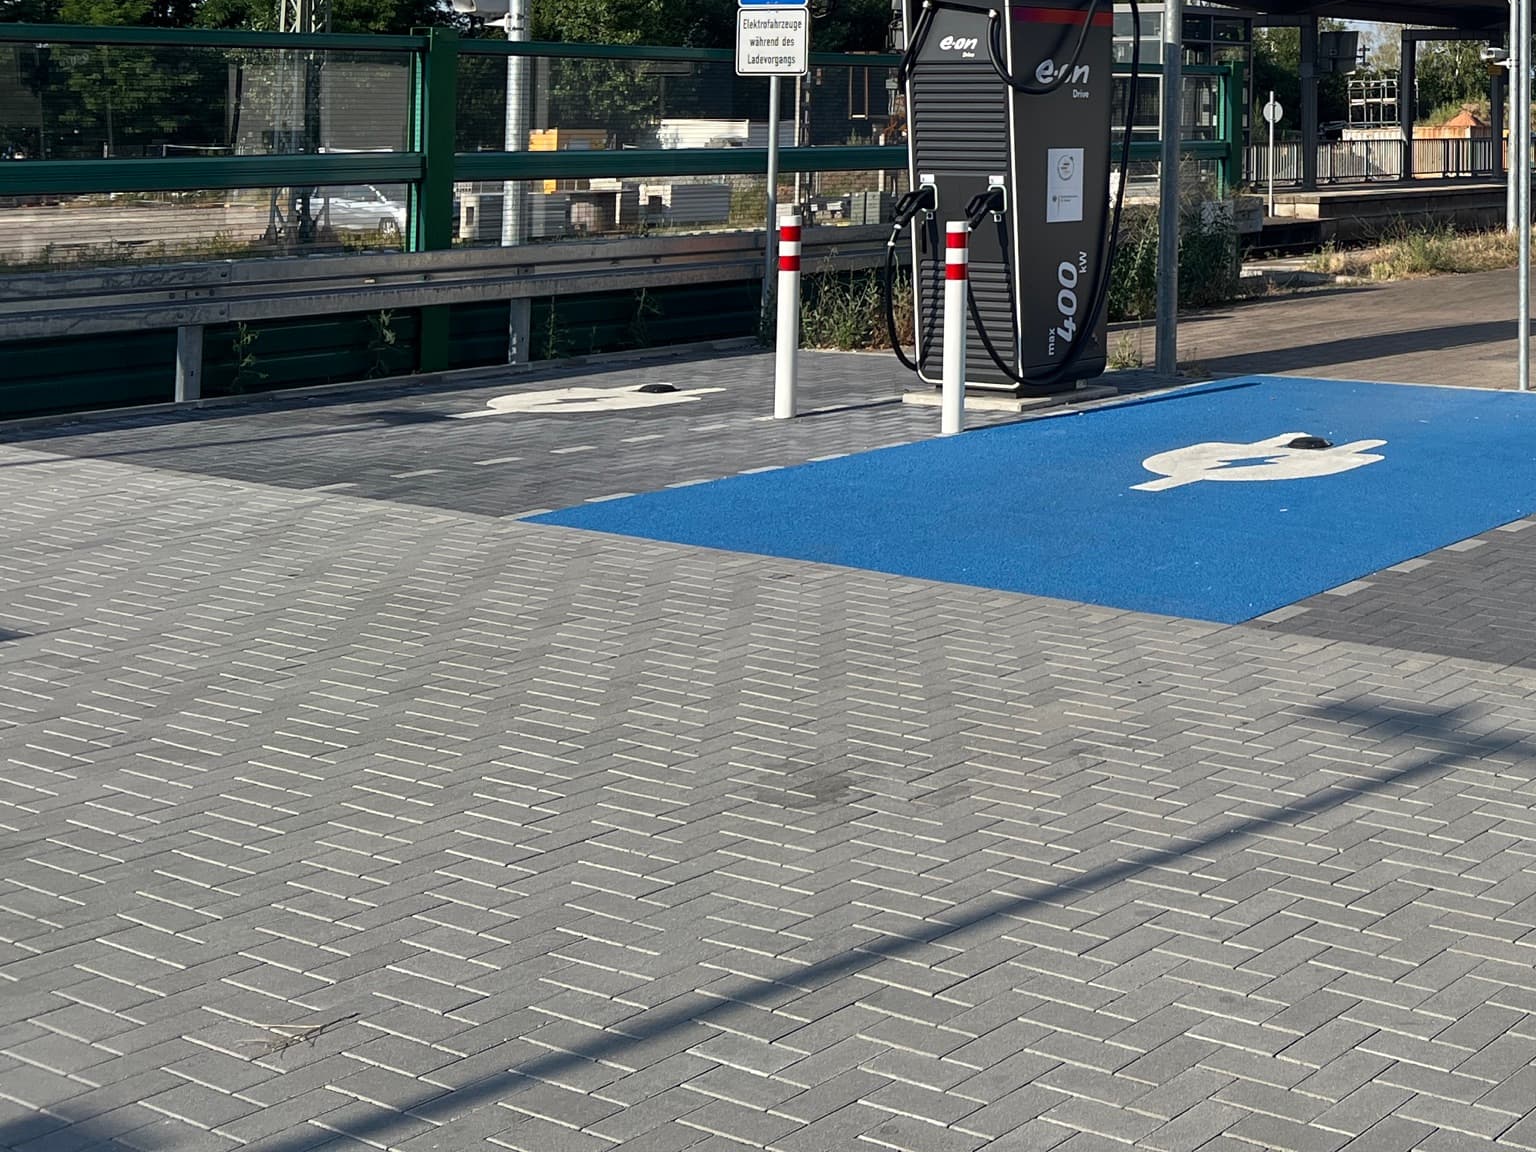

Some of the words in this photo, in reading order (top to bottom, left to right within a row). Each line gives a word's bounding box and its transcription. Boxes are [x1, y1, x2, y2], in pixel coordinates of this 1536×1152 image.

[743, 19, 802, 33] Elektrofahrzeuge
[749, 36, 779, 47] während
[782, 36, 795, 47] des
[747, 53, 796, 67] Ladevorgangs
[1079, 251, 1088, 273] kW
[1057, 261, 1078, 342] 400
[1048, 328, 1056, 356] max
